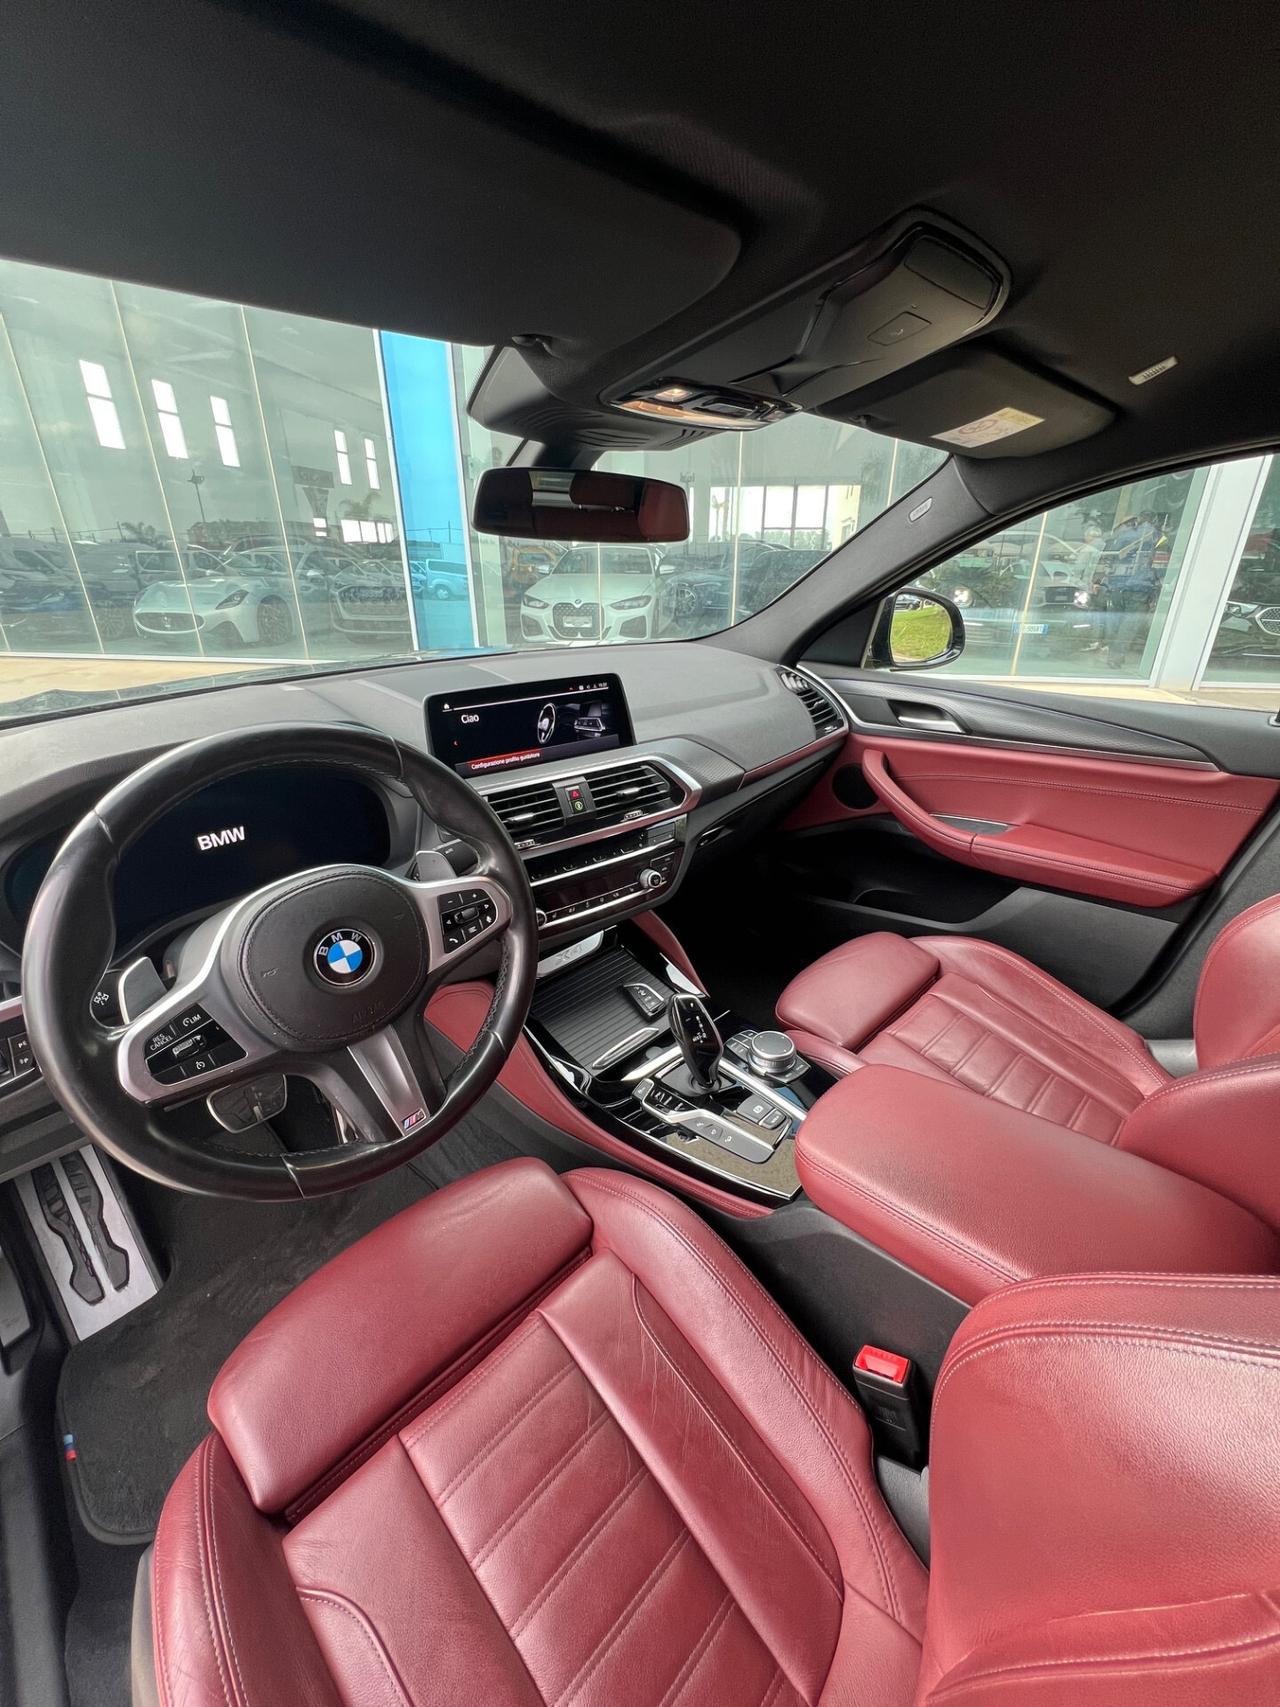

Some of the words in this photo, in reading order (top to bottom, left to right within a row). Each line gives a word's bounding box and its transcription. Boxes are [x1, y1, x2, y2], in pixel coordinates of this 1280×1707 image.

[461, 714, 479, 724] Ciao
[197, 825, 246, 851] BMW
[318, 932, 362, 956] BMW
[190, 1013, 202, 1025] LIM
[149, 1035, 174, 1051] CANCEL
[152, 1033, 166, 1044] RES
